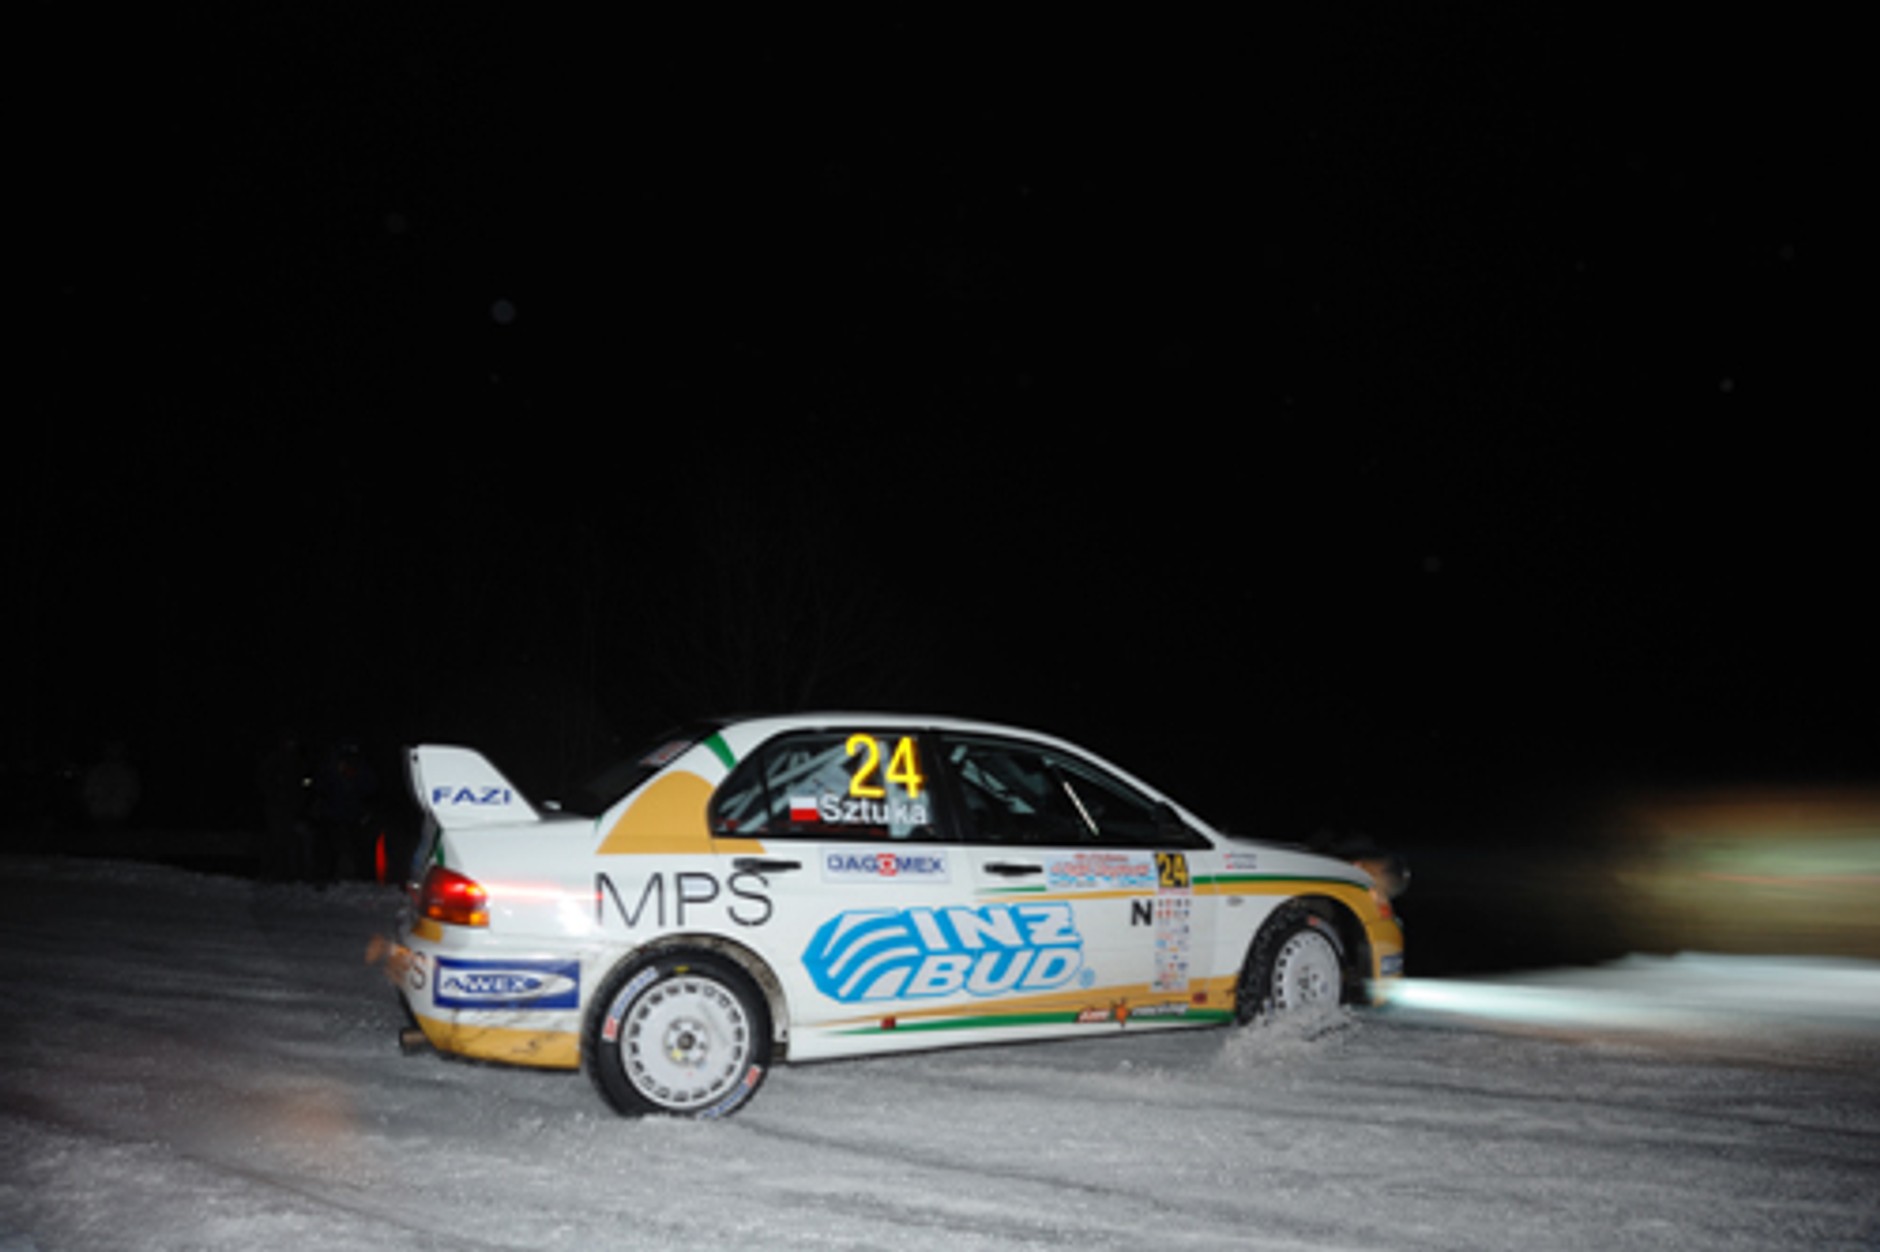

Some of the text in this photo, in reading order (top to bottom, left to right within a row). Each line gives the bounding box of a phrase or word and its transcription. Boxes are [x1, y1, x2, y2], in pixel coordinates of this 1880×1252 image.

[846, 733, 923, 799] 24
[431, 786, 512, 806] FAZI
[819, 796, 929, 826] Sztuka
[826, 853, 945, 876] DAGOMEX
[1156, 851, 1188, 887] 24
[594, 870, 774, 928] MPS
[1131, 900, 1154, 926] N
[443, 972, 530, 994] AWEX
[900, 948, 1084, 997] BUD
